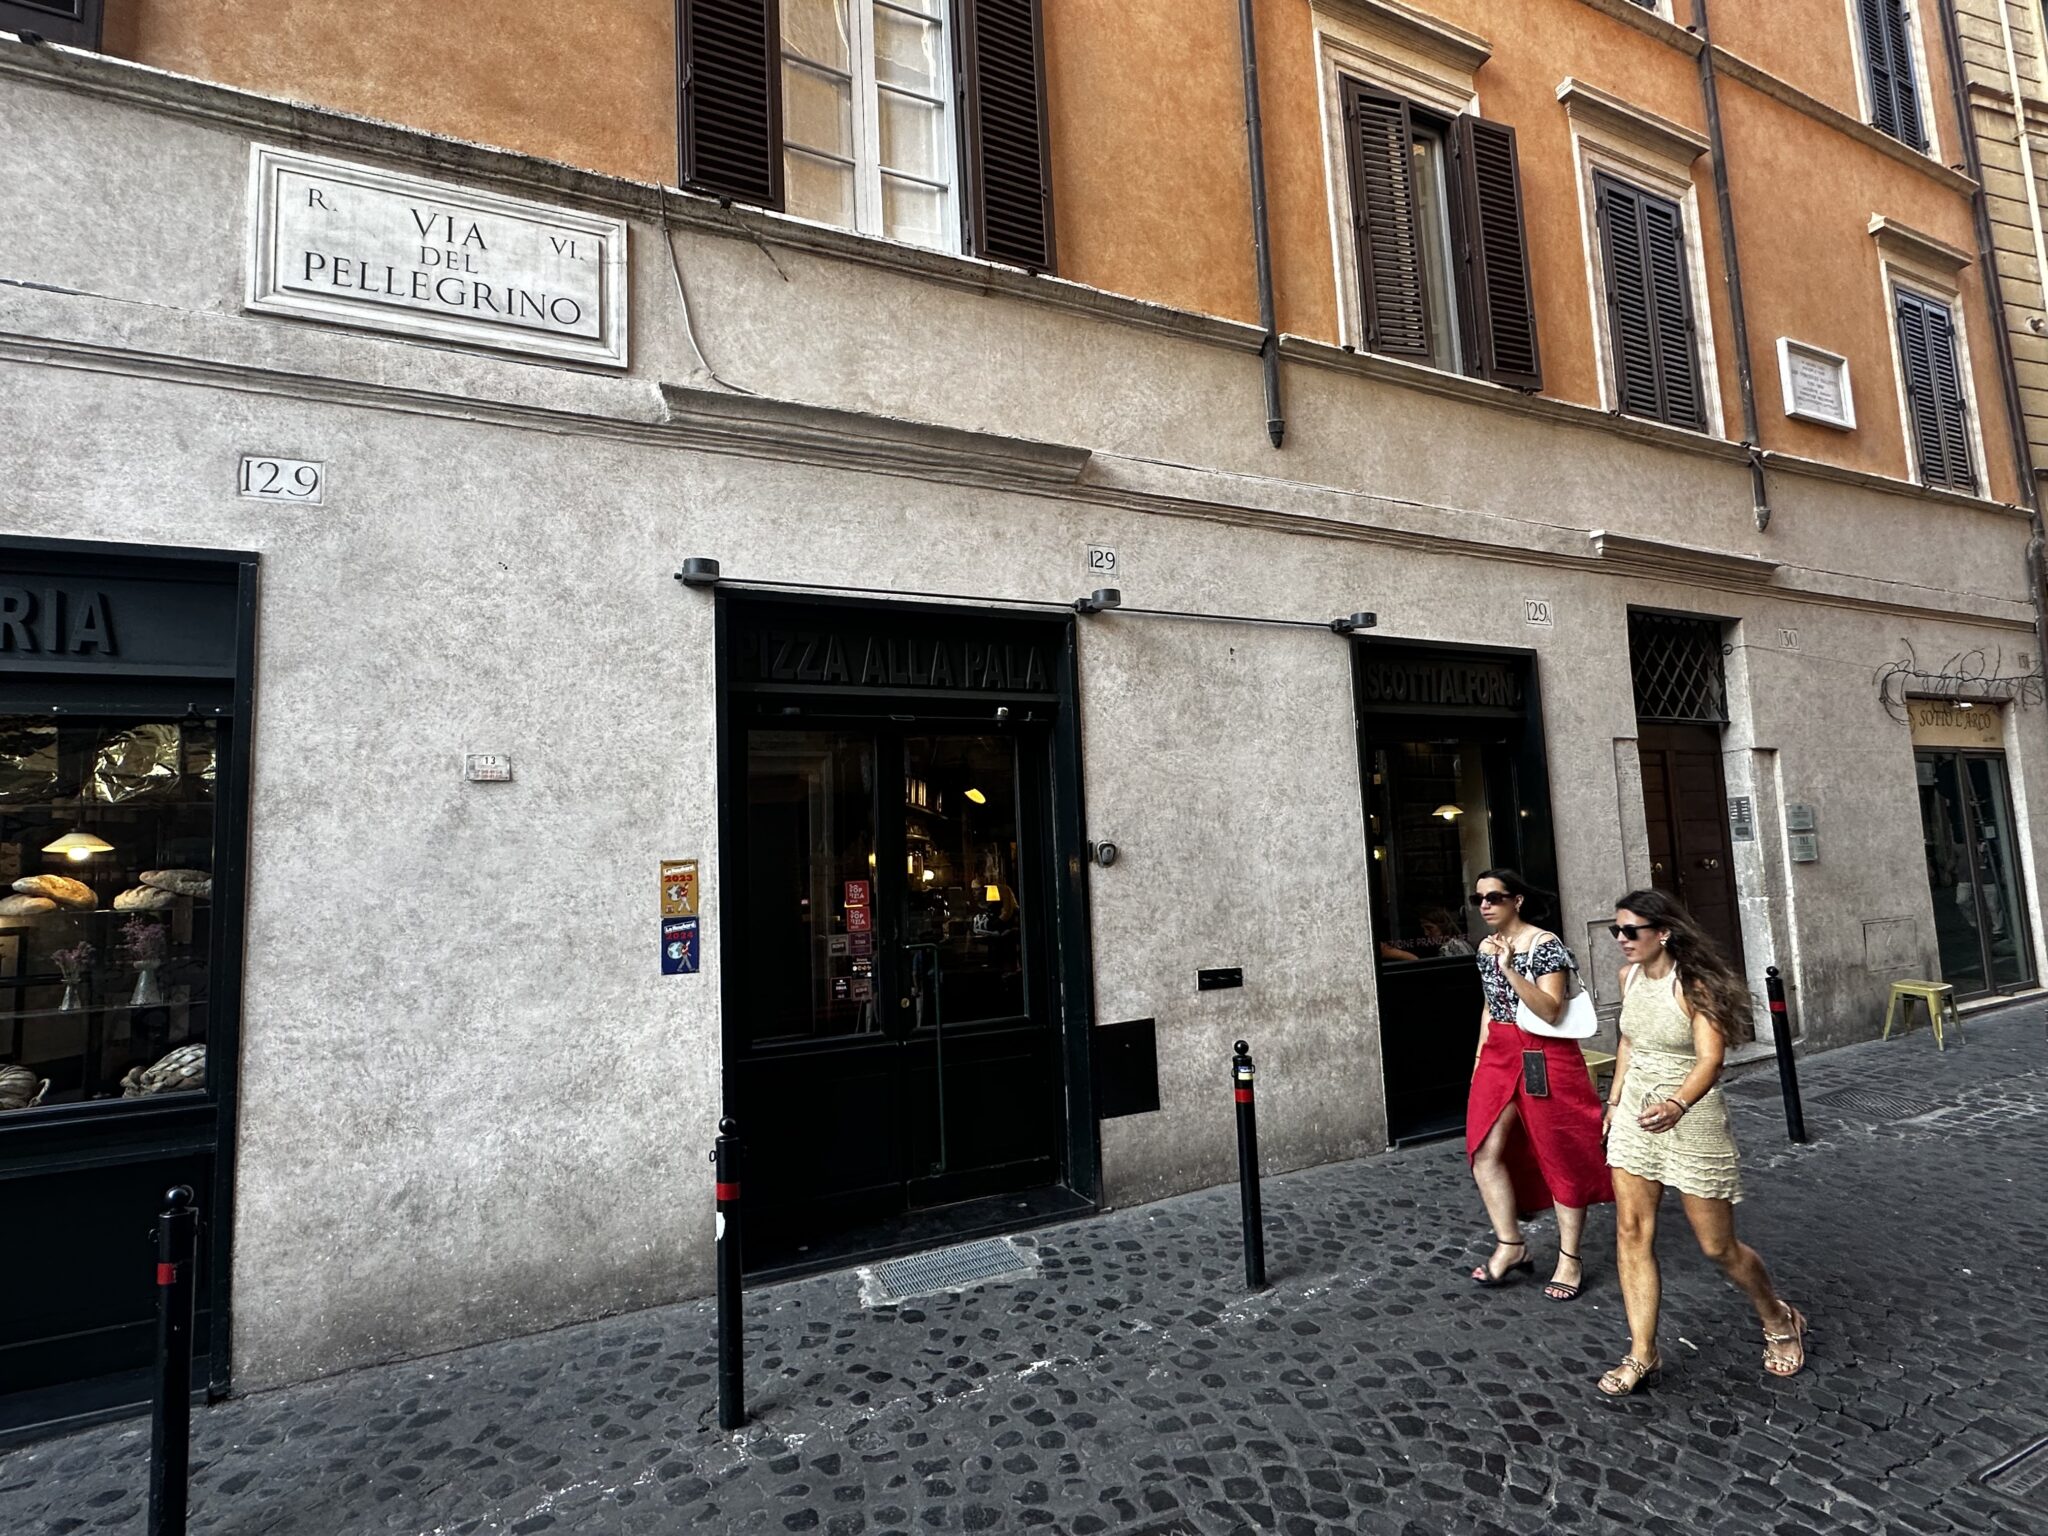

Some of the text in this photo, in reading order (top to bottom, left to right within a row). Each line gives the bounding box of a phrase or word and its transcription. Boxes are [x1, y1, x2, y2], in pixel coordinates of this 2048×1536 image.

[410, 206, 488, 251] VIA
[420, 245, 479, 275] DEL
[303, 250, 582, 326] PELLEGRINO
[242, 459, 319, 497] 129
[1090, 550, 1116, 570] 129
[861, 633, 952, 688] ALLA
[964, 640, 1049, 690] PALA
[1919, 709, 1953, 728] SOTTO
[664, 874, 693, 882] 2023
